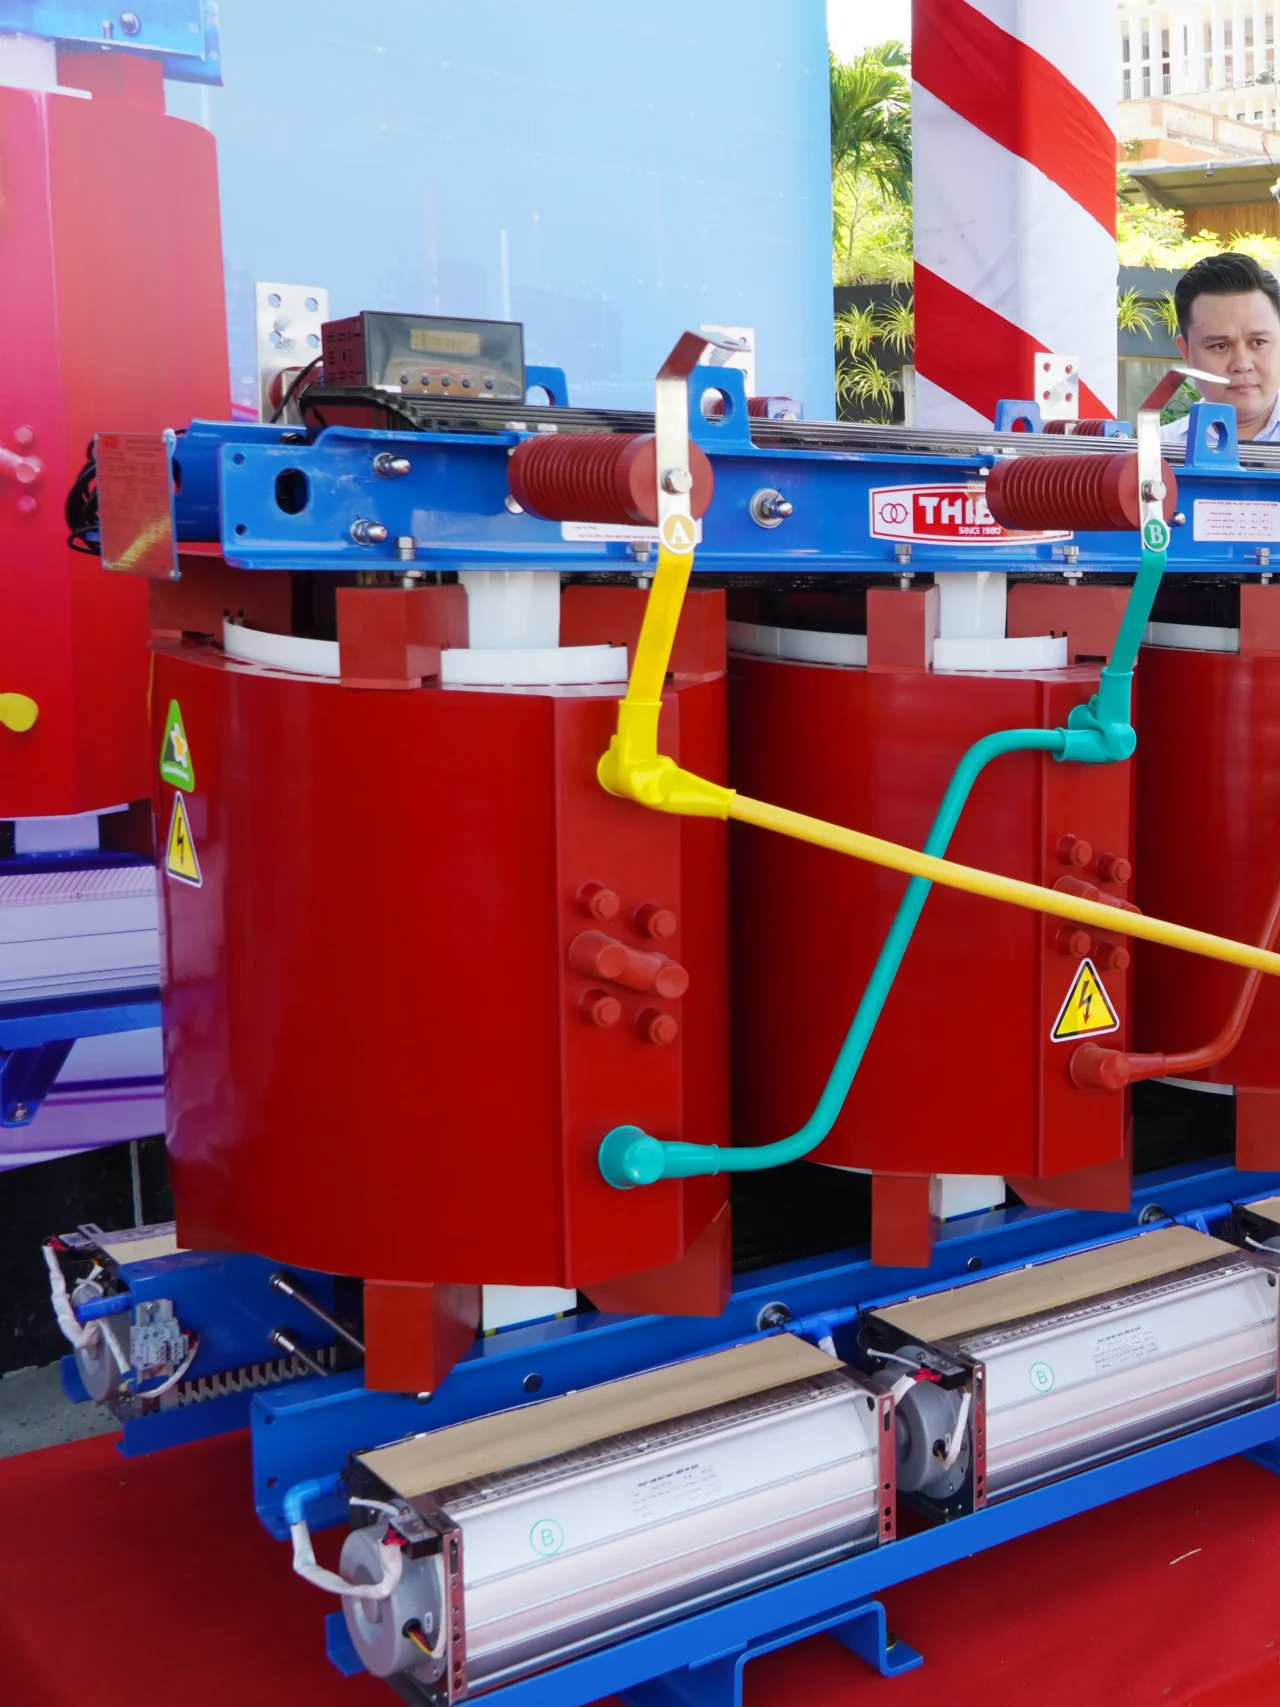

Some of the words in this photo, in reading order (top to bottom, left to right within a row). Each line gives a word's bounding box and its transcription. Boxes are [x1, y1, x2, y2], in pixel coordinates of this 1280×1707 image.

[918, 495, 997, 526] THIB
[668, 520, 692, 545] A
[958, 526, 981, 536] SINCE
[982, 526, 1001, 535] 1980
[1147, 523, 1164, 545] B
[1036, 1370, 1048, 1384] B
[540, 1528, 555, 1547] B
